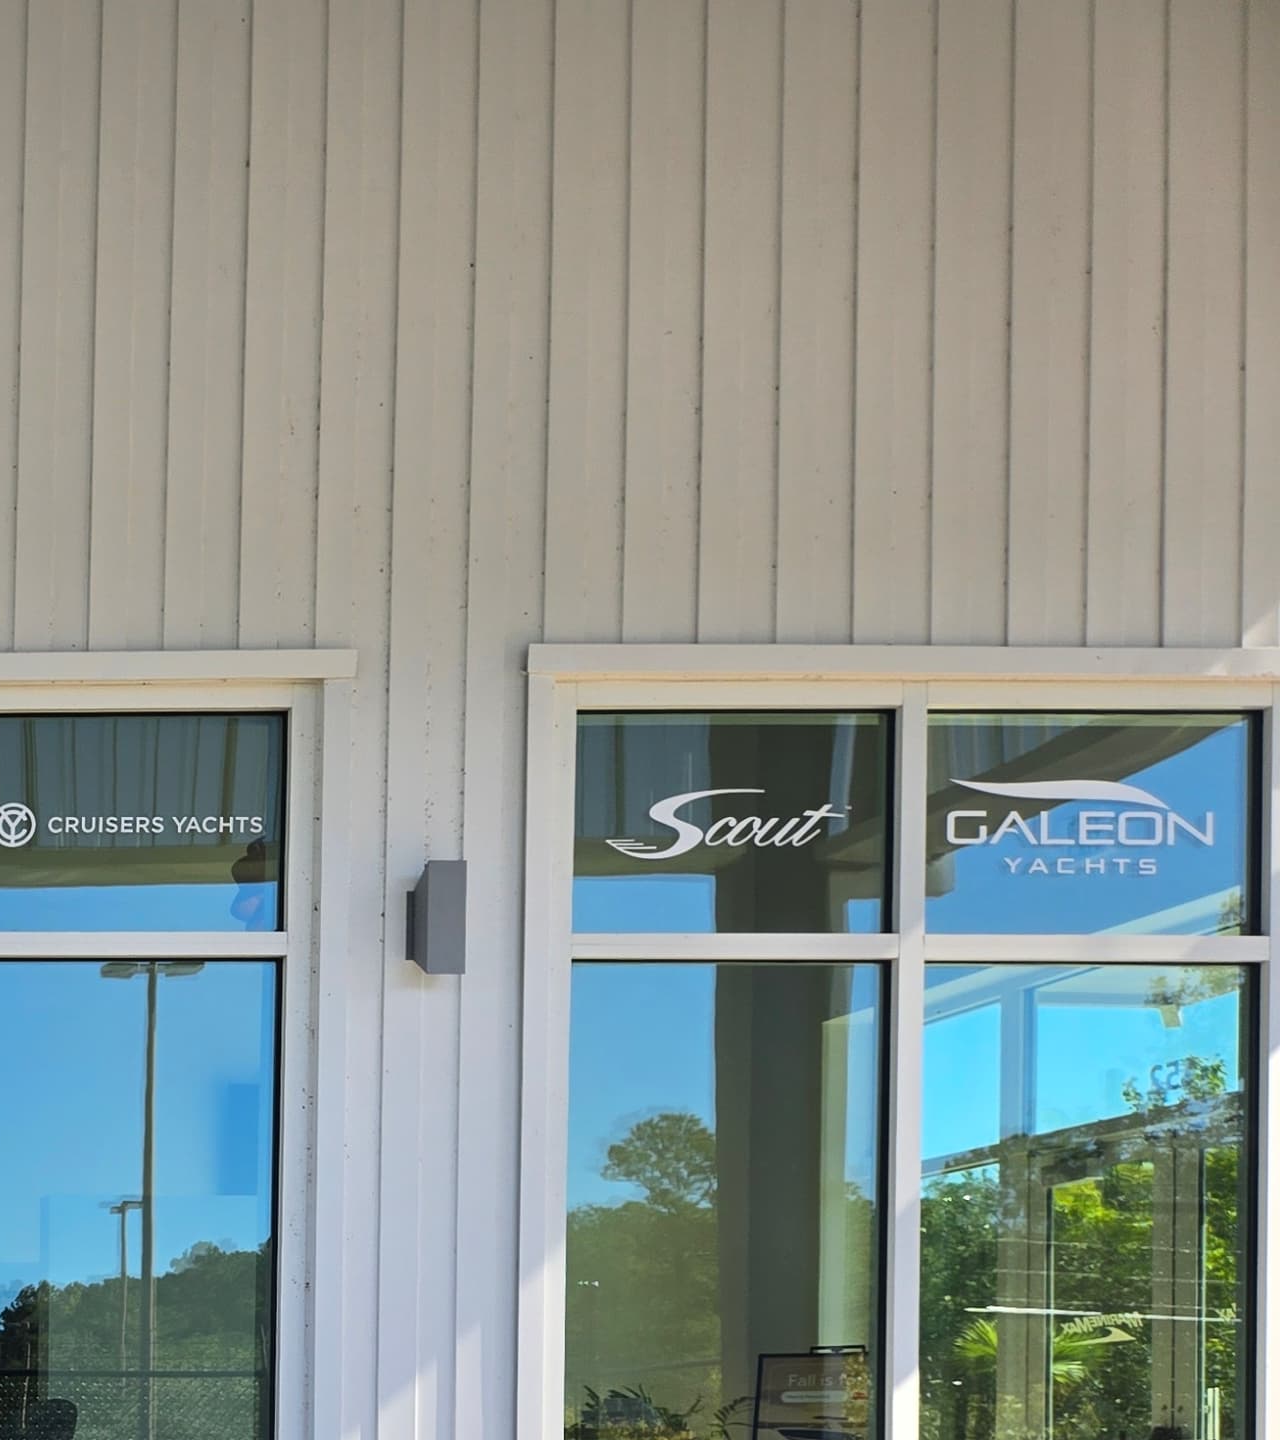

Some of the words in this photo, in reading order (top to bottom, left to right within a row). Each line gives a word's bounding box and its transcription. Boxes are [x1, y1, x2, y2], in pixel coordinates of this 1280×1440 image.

[48, 816, 165, 833] CRUISERS
[172, 816, 263, 833] YACHTS
[605, 788, 846, 860] Scout
[946, 810, 1214, 846] GALEON
[1004, 856, 1157, 875] YACHTS
